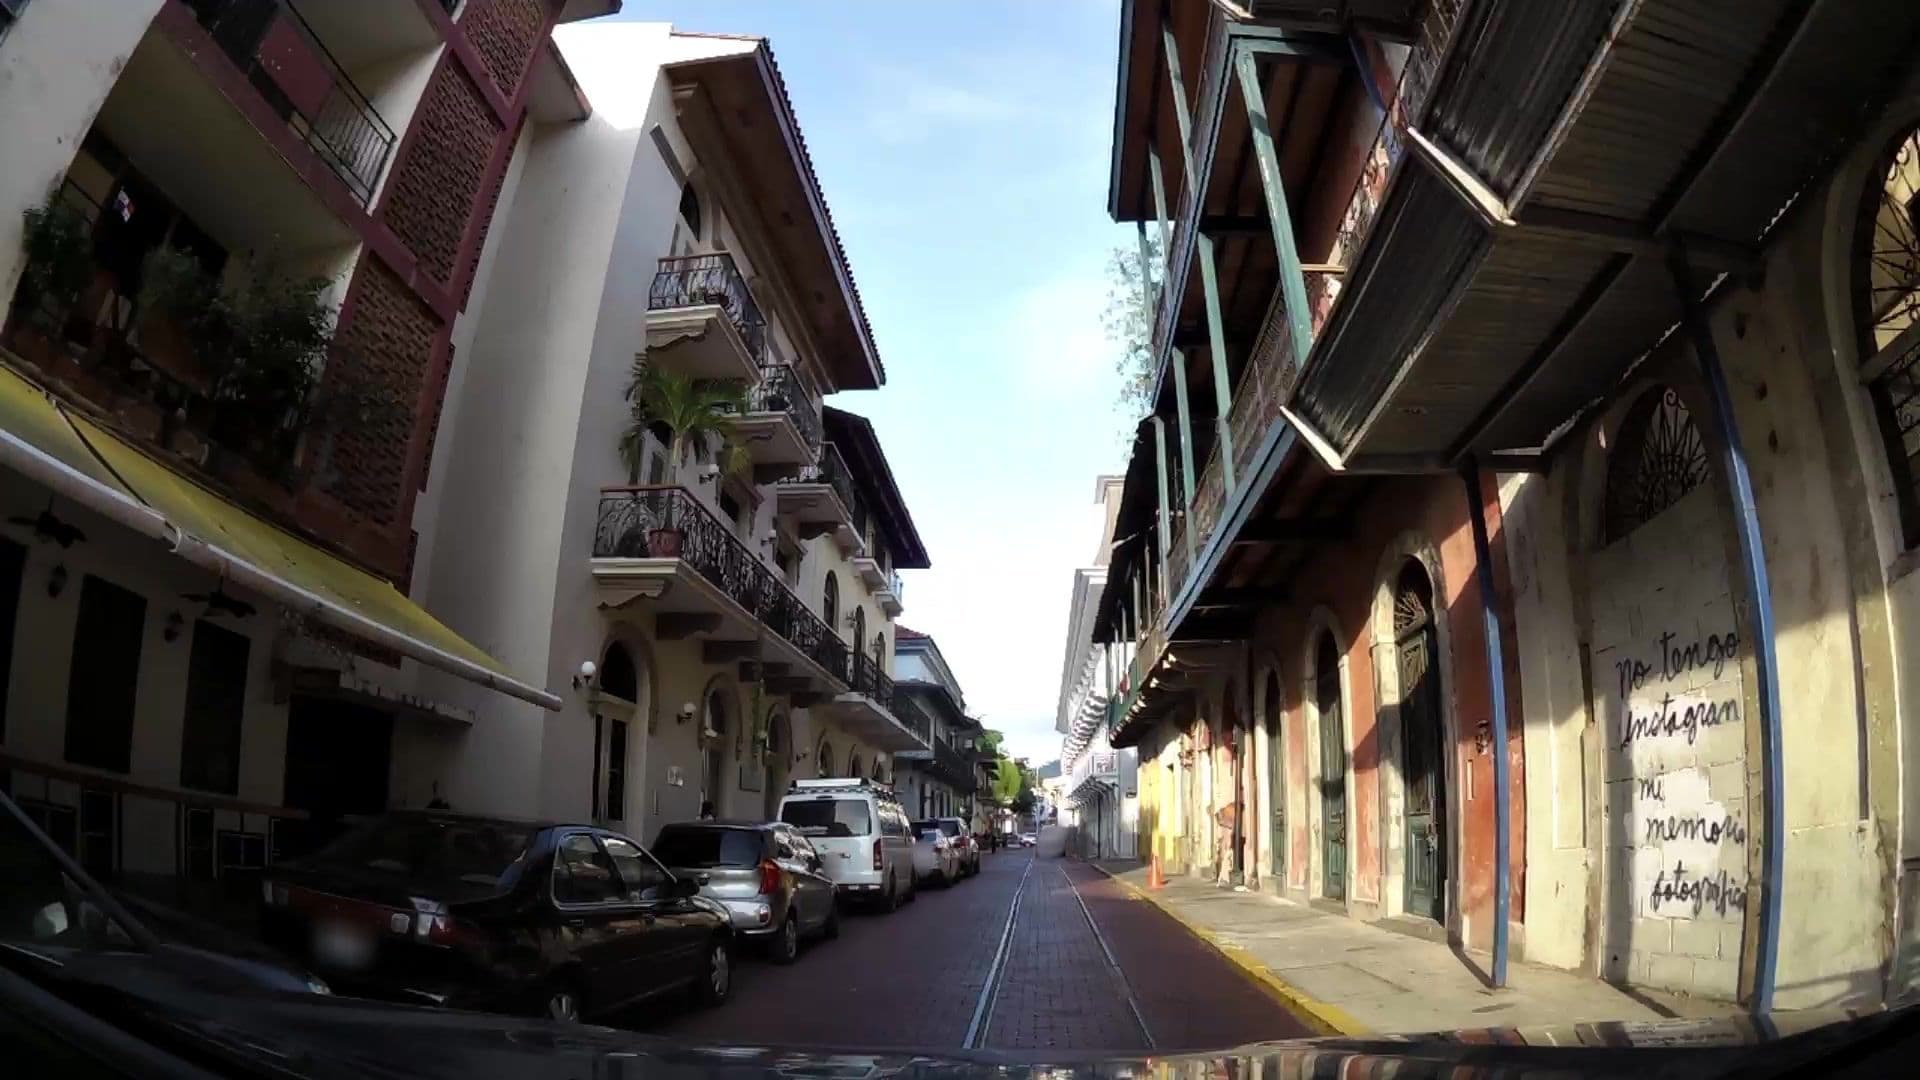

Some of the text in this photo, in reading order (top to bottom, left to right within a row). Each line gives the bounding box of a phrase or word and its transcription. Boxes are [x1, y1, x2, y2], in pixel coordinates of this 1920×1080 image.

[1616, 631, 1740, 698] no tengo
[1638, 764, 1665, 800] mi
[1646, 809, 1745, 846] memoria
